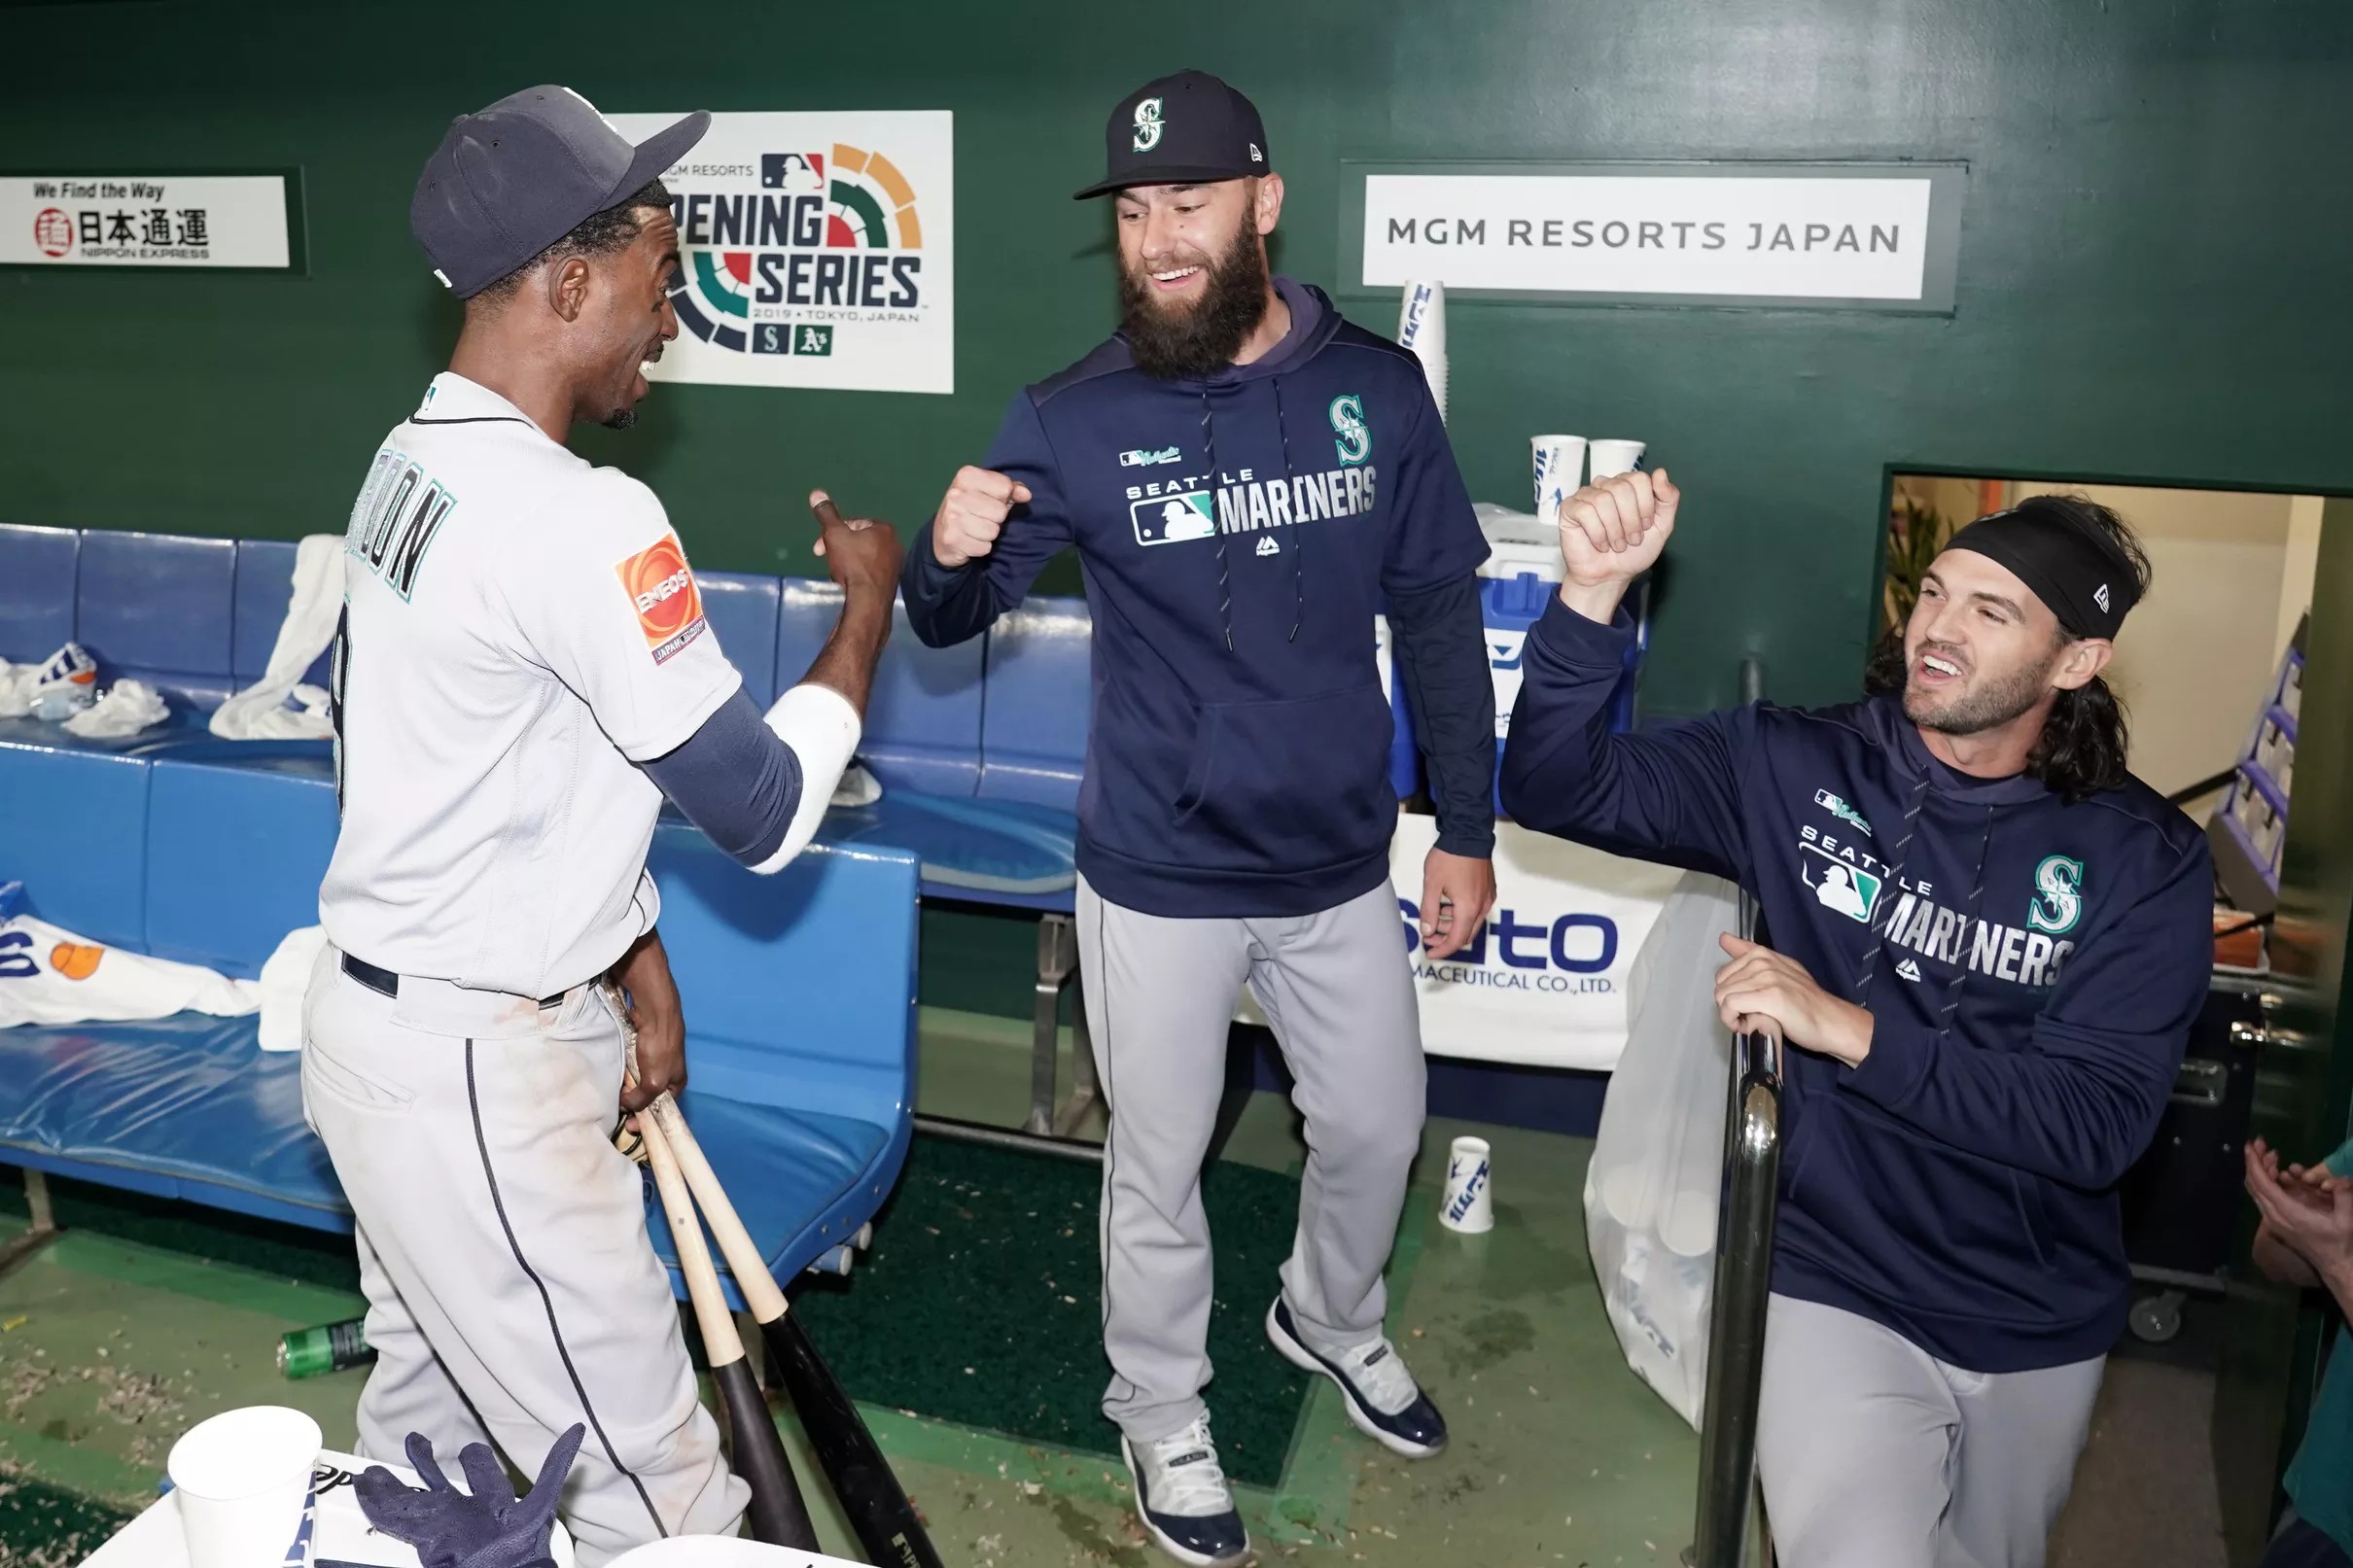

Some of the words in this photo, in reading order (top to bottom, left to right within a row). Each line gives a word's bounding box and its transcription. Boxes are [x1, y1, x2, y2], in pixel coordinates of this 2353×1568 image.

[666, 164, 688, 175] GM
[692, 164, 754, 176] RESORTS
[34, 183, 56, 198] We
[60, 183, 96, 198] Find
[101, 183, 126, 198] the
[130, 183, 164, 202] Way
[79, 208, 209, 246] 日本通運
[1387, 218, 1487, 246] MGM
[1508, 219, 1728, 250] RESORTS
[1747, 224, 1900, 253] JAPAN
[81, 248, 136, 259] NIPPON
[139, 248, 210, 260] EXPRESS
[755, 254, 921, 308] SERIES
[754, 308, 791, 319] 2019
[867, 312, 920, 322] JAPAN
[1216, 466, 1377, 535] MARINERS
[635, 569, 688, 614] ENEOS
